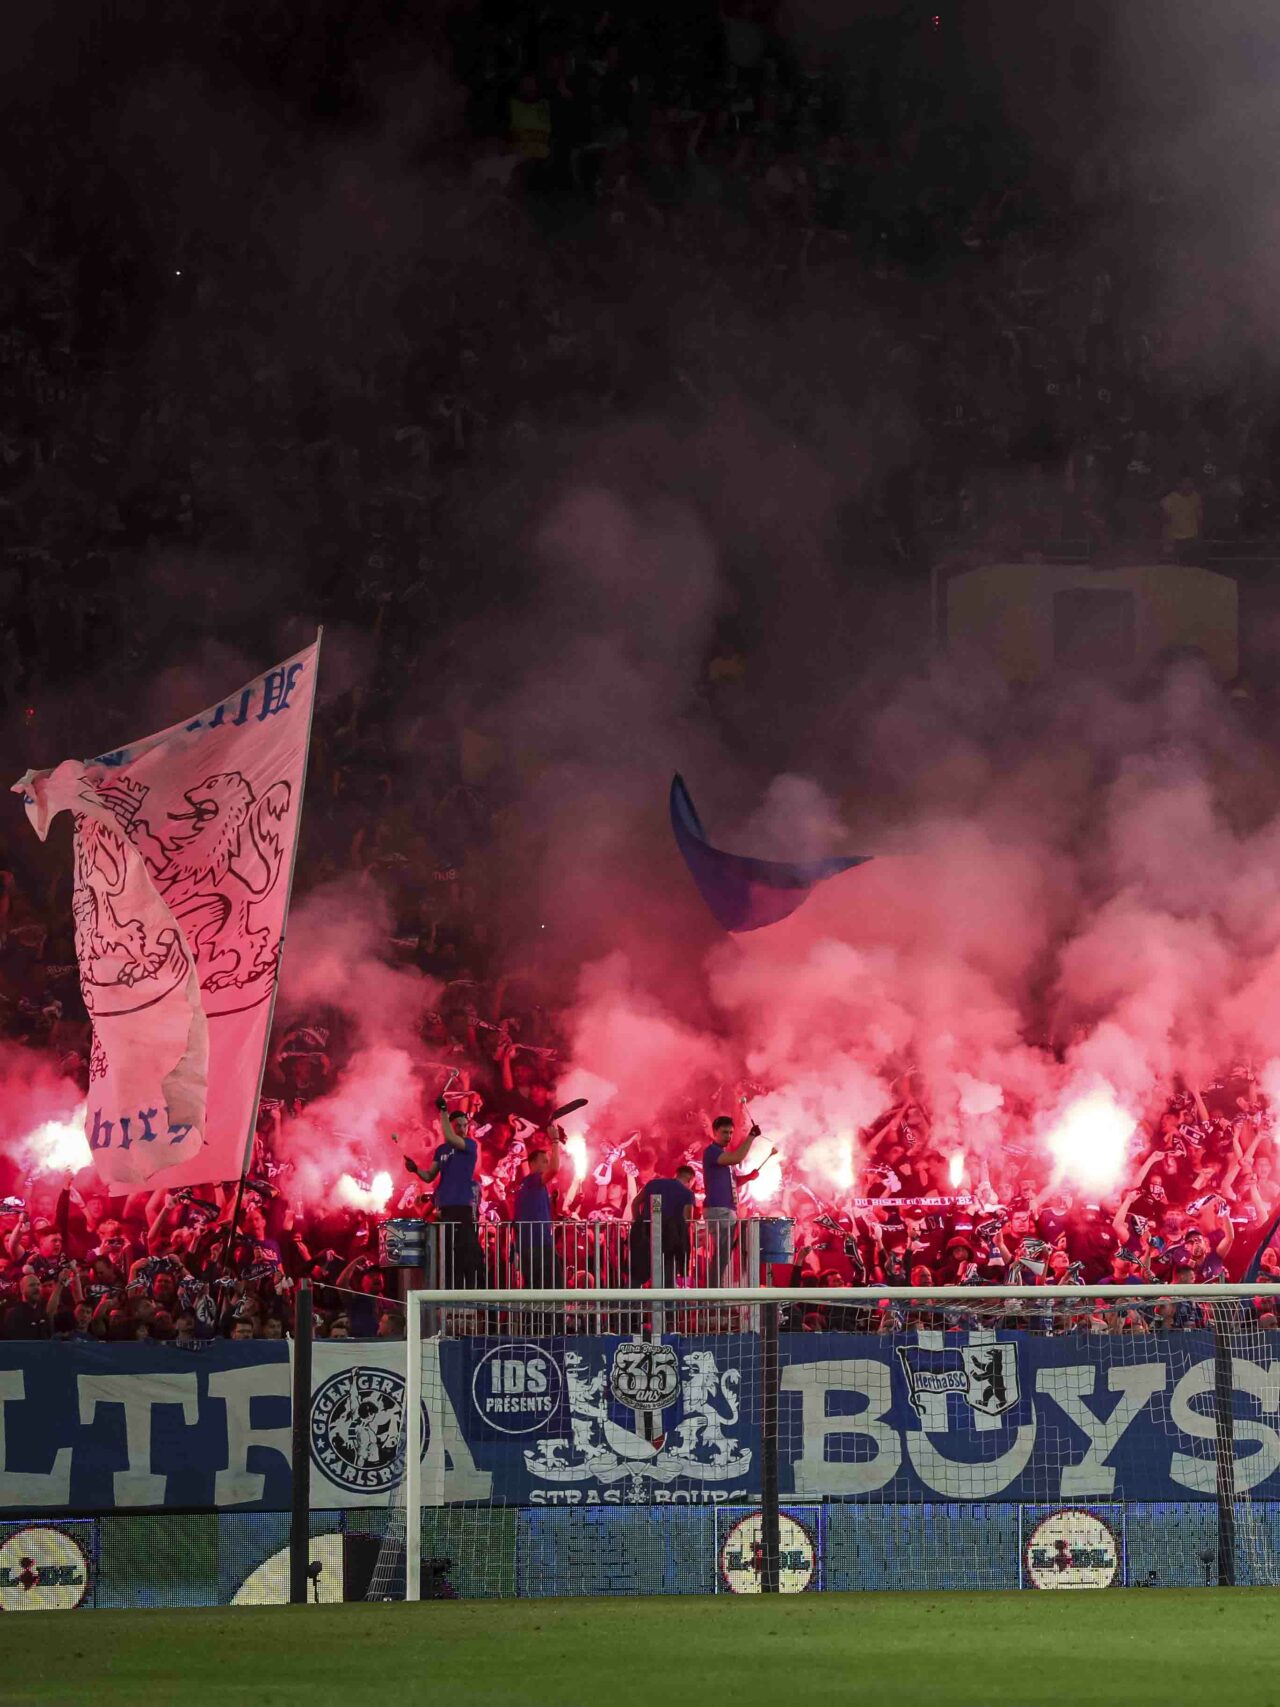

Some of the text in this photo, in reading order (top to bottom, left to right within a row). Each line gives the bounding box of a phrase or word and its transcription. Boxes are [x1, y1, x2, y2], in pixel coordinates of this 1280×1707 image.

[491, 1358, 548, 1394] IDS
[615, 1351, 677, 1395] 35
[486, 1395, 552, 1414] PRÉSENTS
